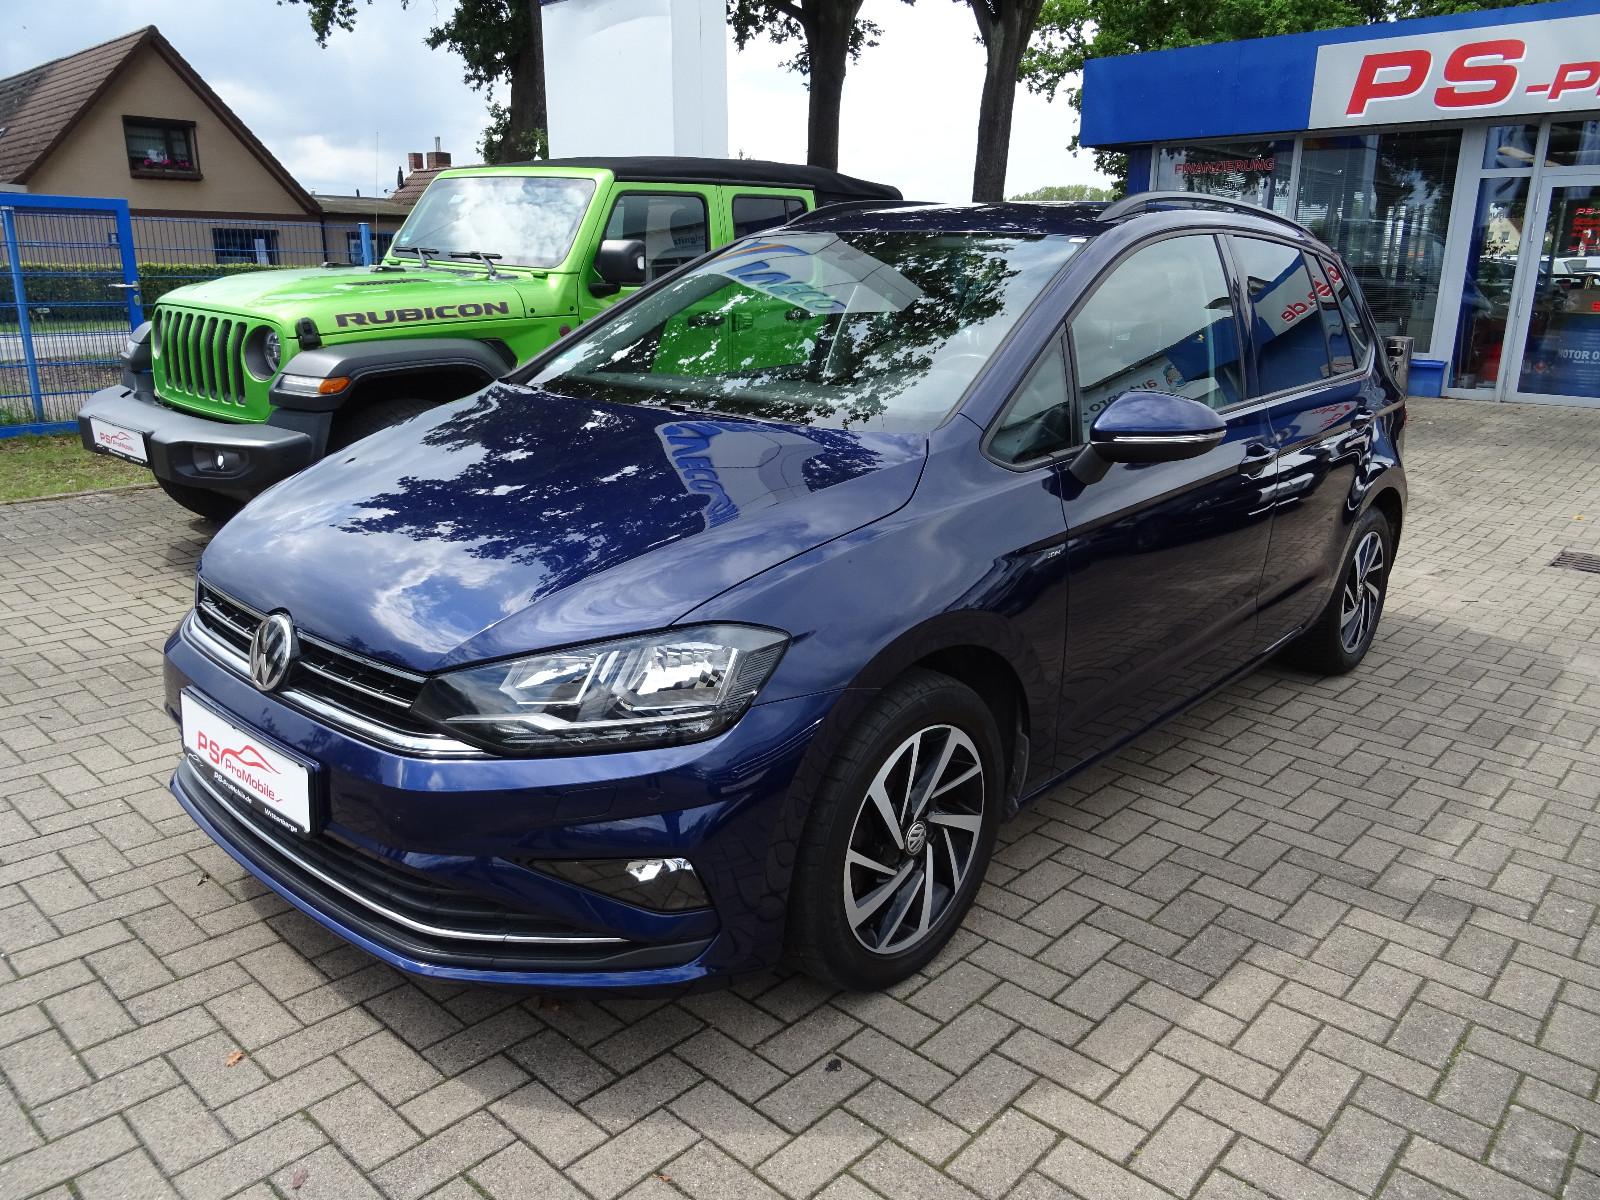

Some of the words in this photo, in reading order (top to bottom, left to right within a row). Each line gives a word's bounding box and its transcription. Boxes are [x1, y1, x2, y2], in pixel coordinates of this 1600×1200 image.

[1346, 39, 1600, 117] PS-P
[1174, 158, 1275, 175] FINANZIERUNG
[335, 301, 510, 328] RUBICON
[198, 730, 220, 766] PS
[225, 757, 275, 801] ProMobile
